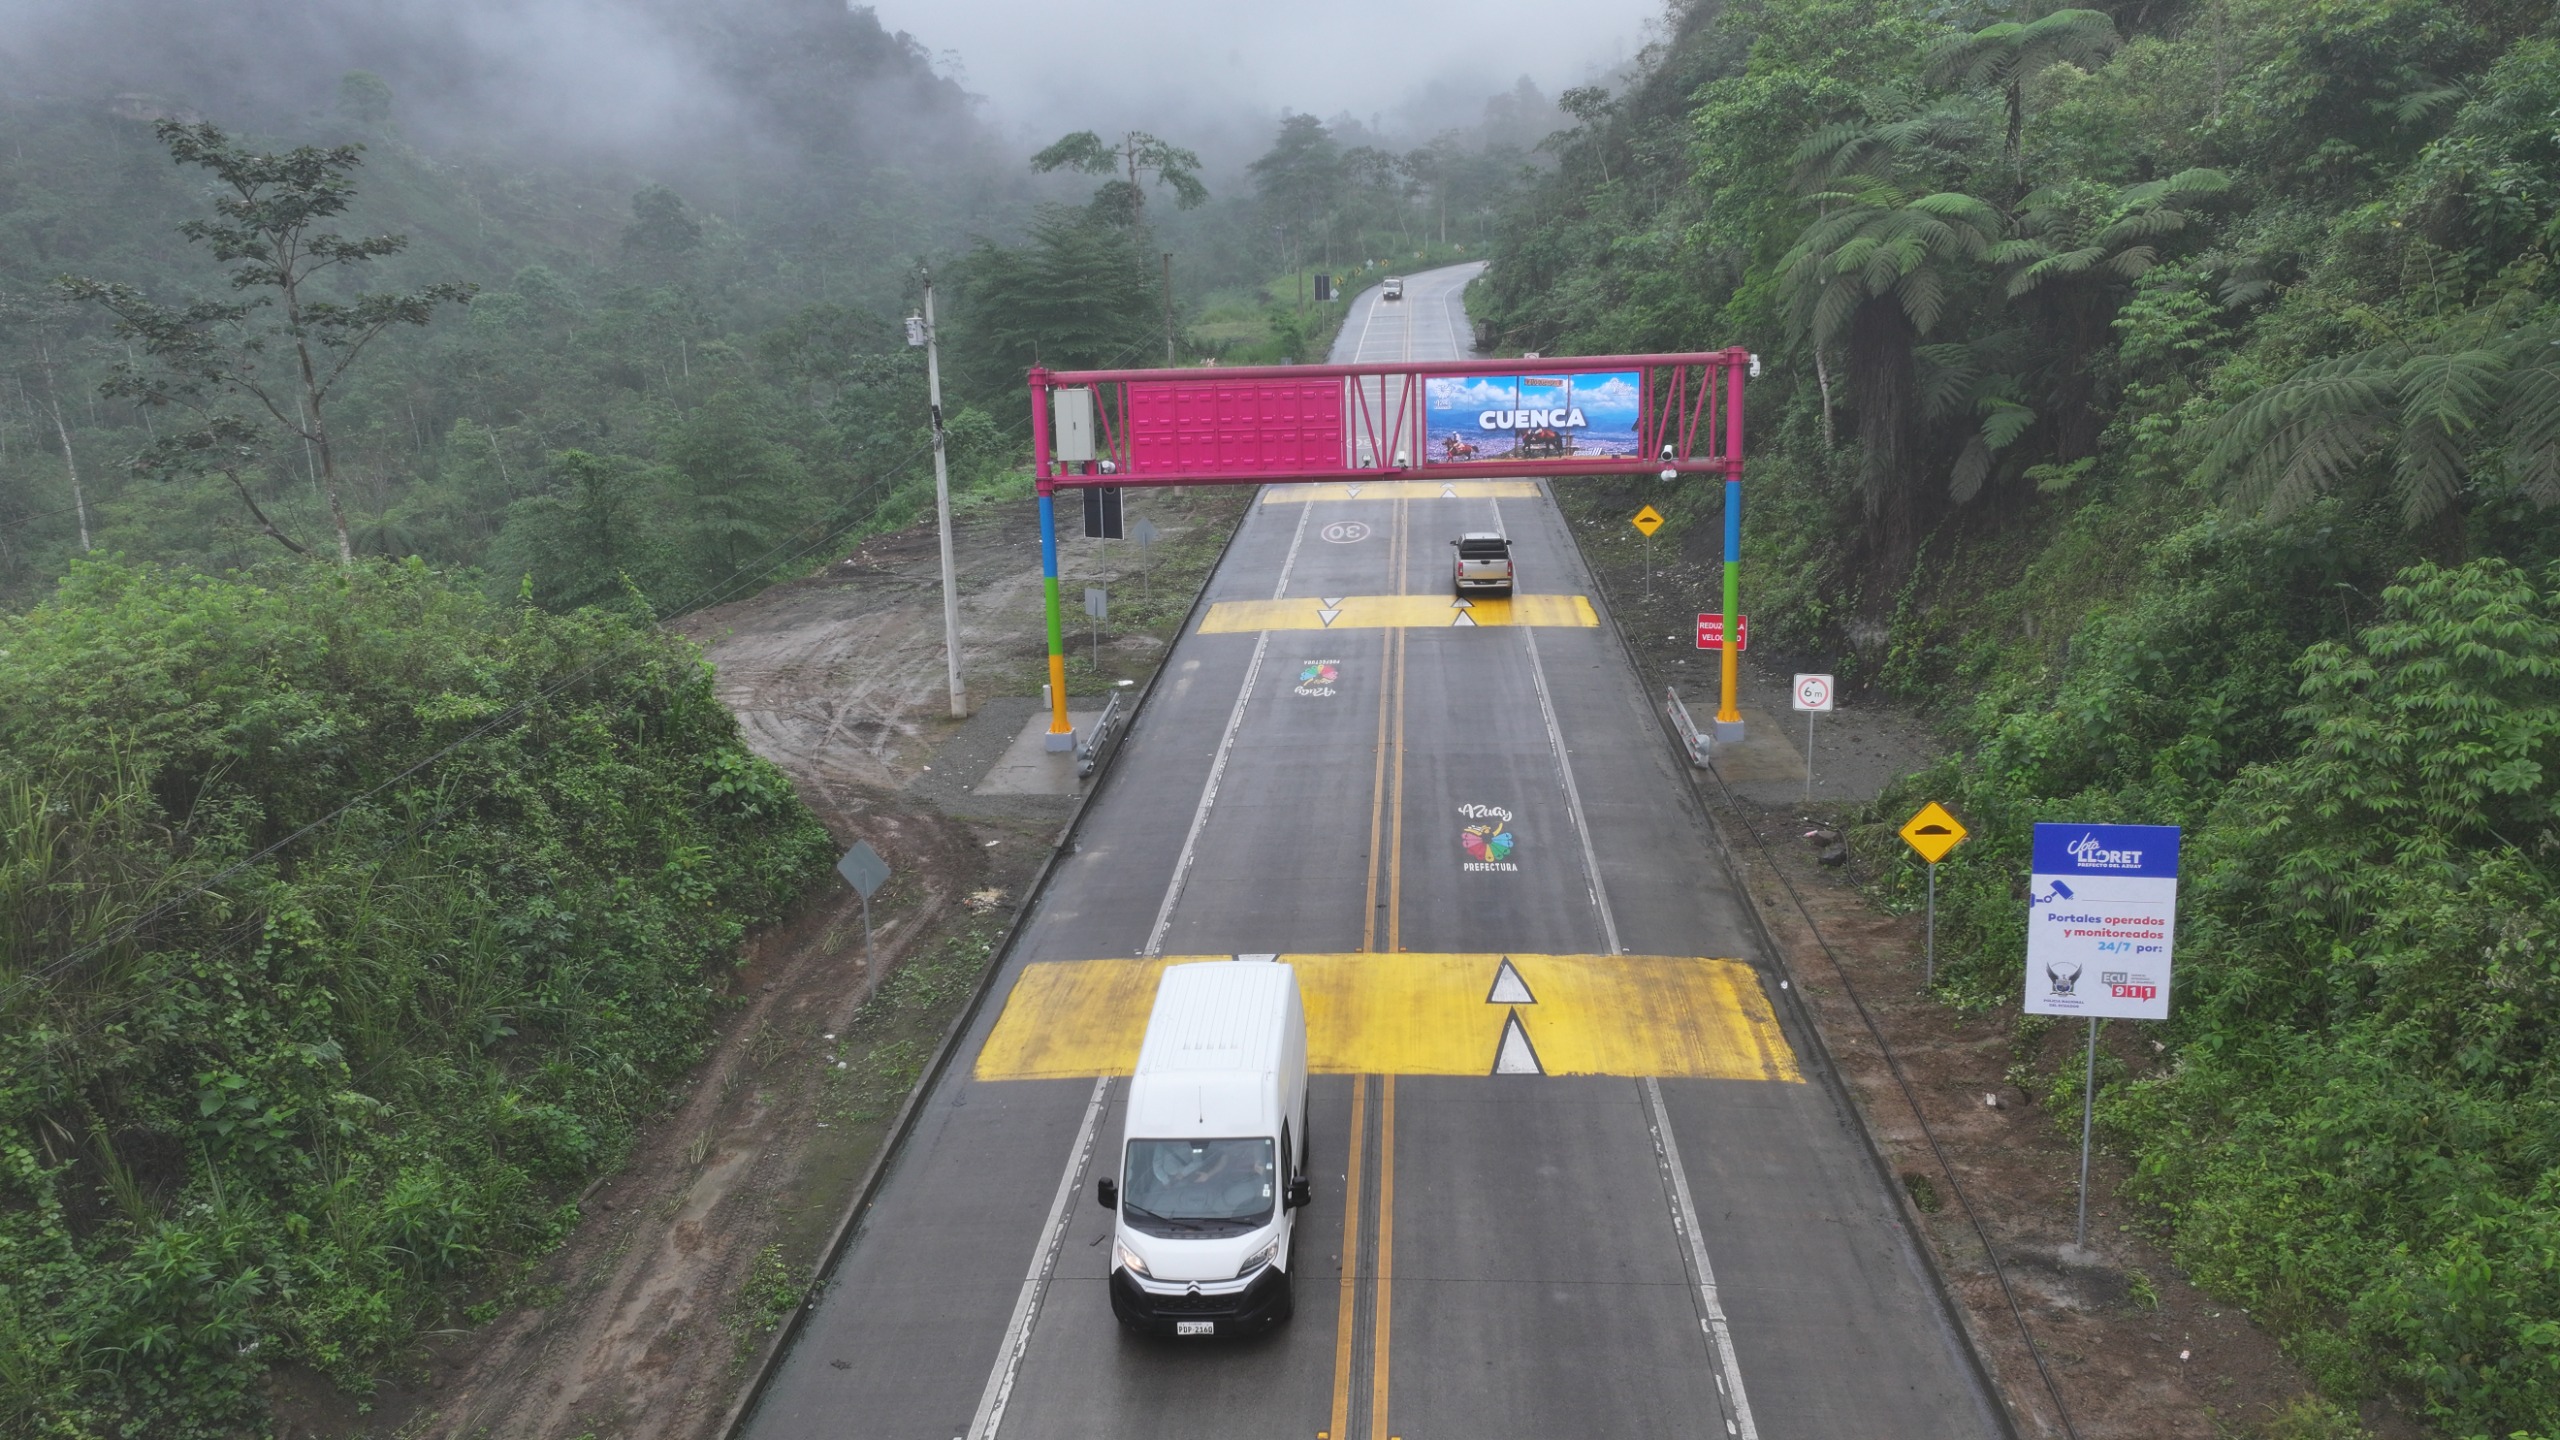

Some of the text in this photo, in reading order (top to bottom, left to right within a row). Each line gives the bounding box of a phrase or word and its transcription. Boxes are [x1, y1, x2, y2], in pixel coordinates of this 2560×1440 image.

[1479, 408, 1586, 430] CUENCA
[1328, 525, 1361, 539] 30
[1294, 686, 1337, 697] Azuay
[1804, 687, 1812, 697] 6
[1458, 803, 1512, 822] Azuay
[2078, 850, 2143, 864] LLORET
[1463, 862, 1518, 871] PREFECTURA
[2048, 913, 2165, 926] Portales operados
[2064, 928, 2164, 939] y monitoreados
[2098, 941, 2162, 954] 24/7 por:
[2103, 973, 2126, 983] ECU
[2115, 986, 2152, 997] 911
